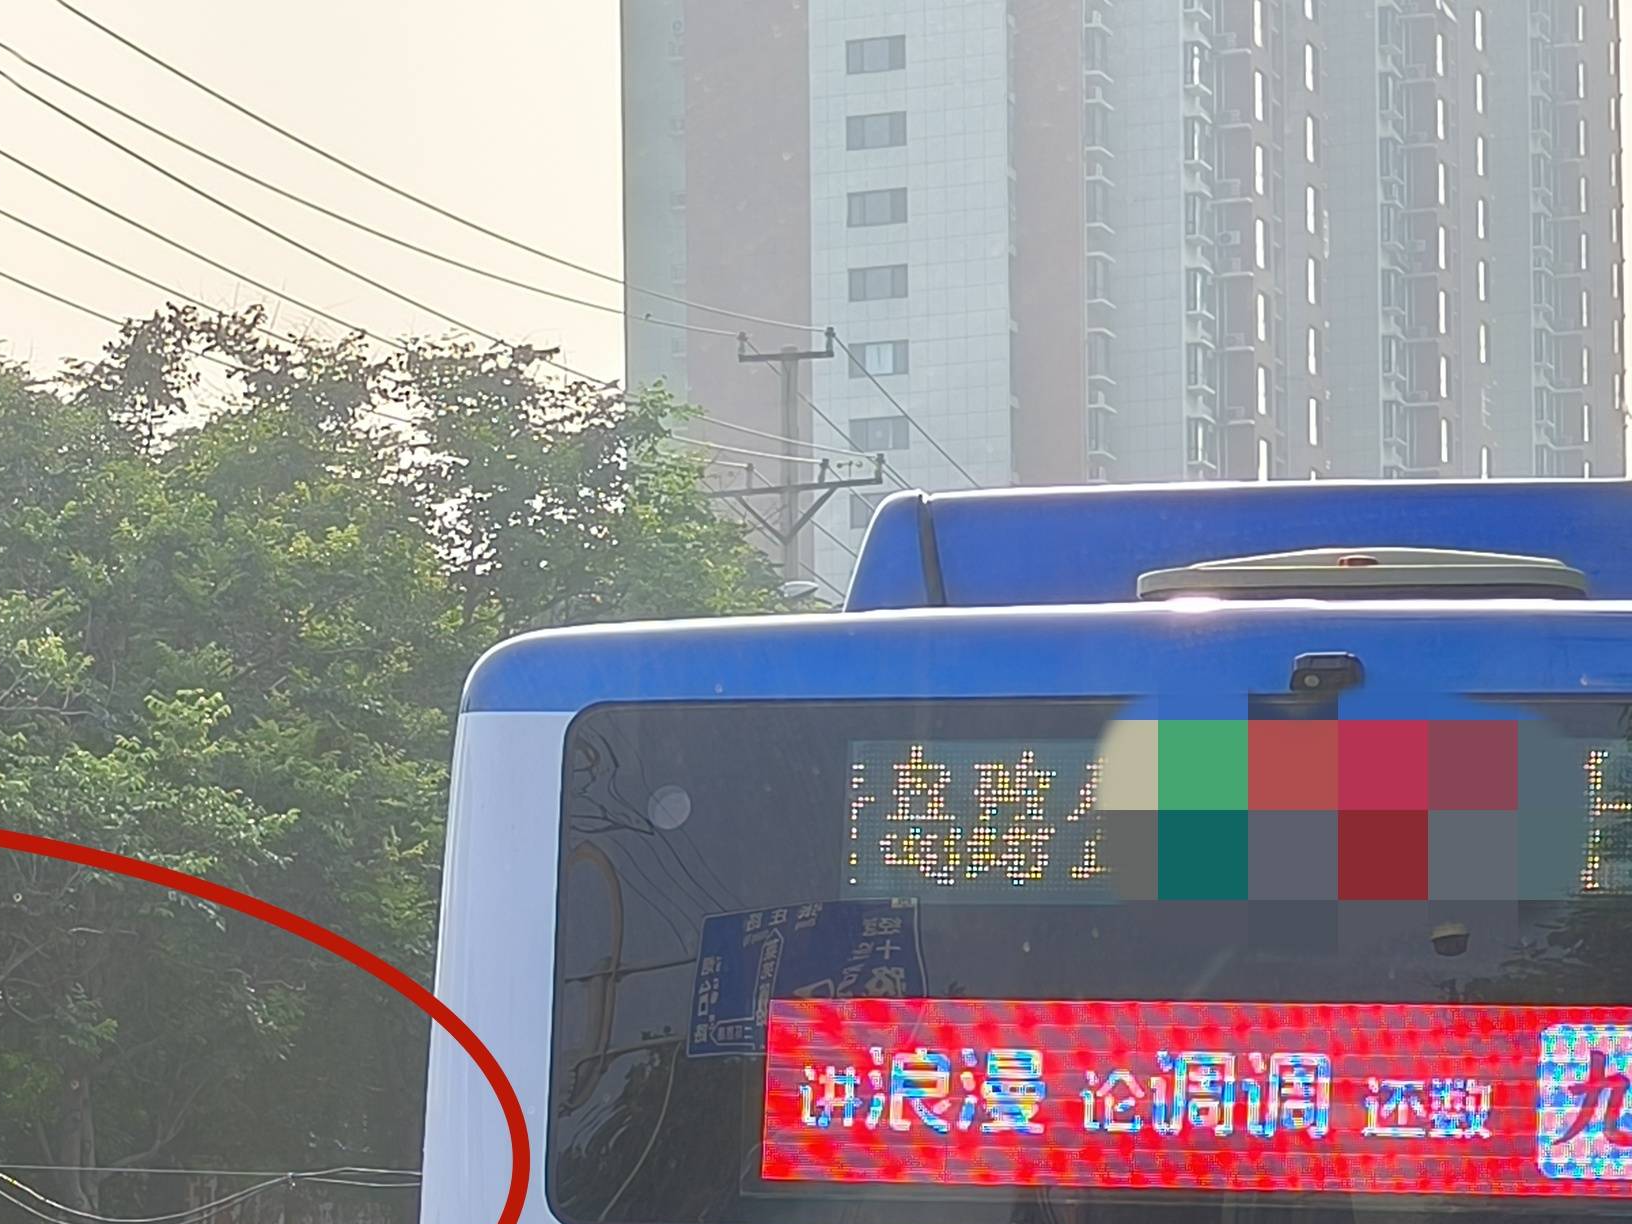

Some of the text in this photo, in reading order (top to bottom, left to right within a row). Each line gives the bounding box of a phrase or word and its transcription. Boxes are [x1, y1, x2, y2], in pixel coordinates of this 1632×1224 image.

[799, 1046, 1046, 1135] 讲浪漫
[1082, 1048, 1333, 1137] 论调调
[1361, 1076, 1493, 1139] 还数
